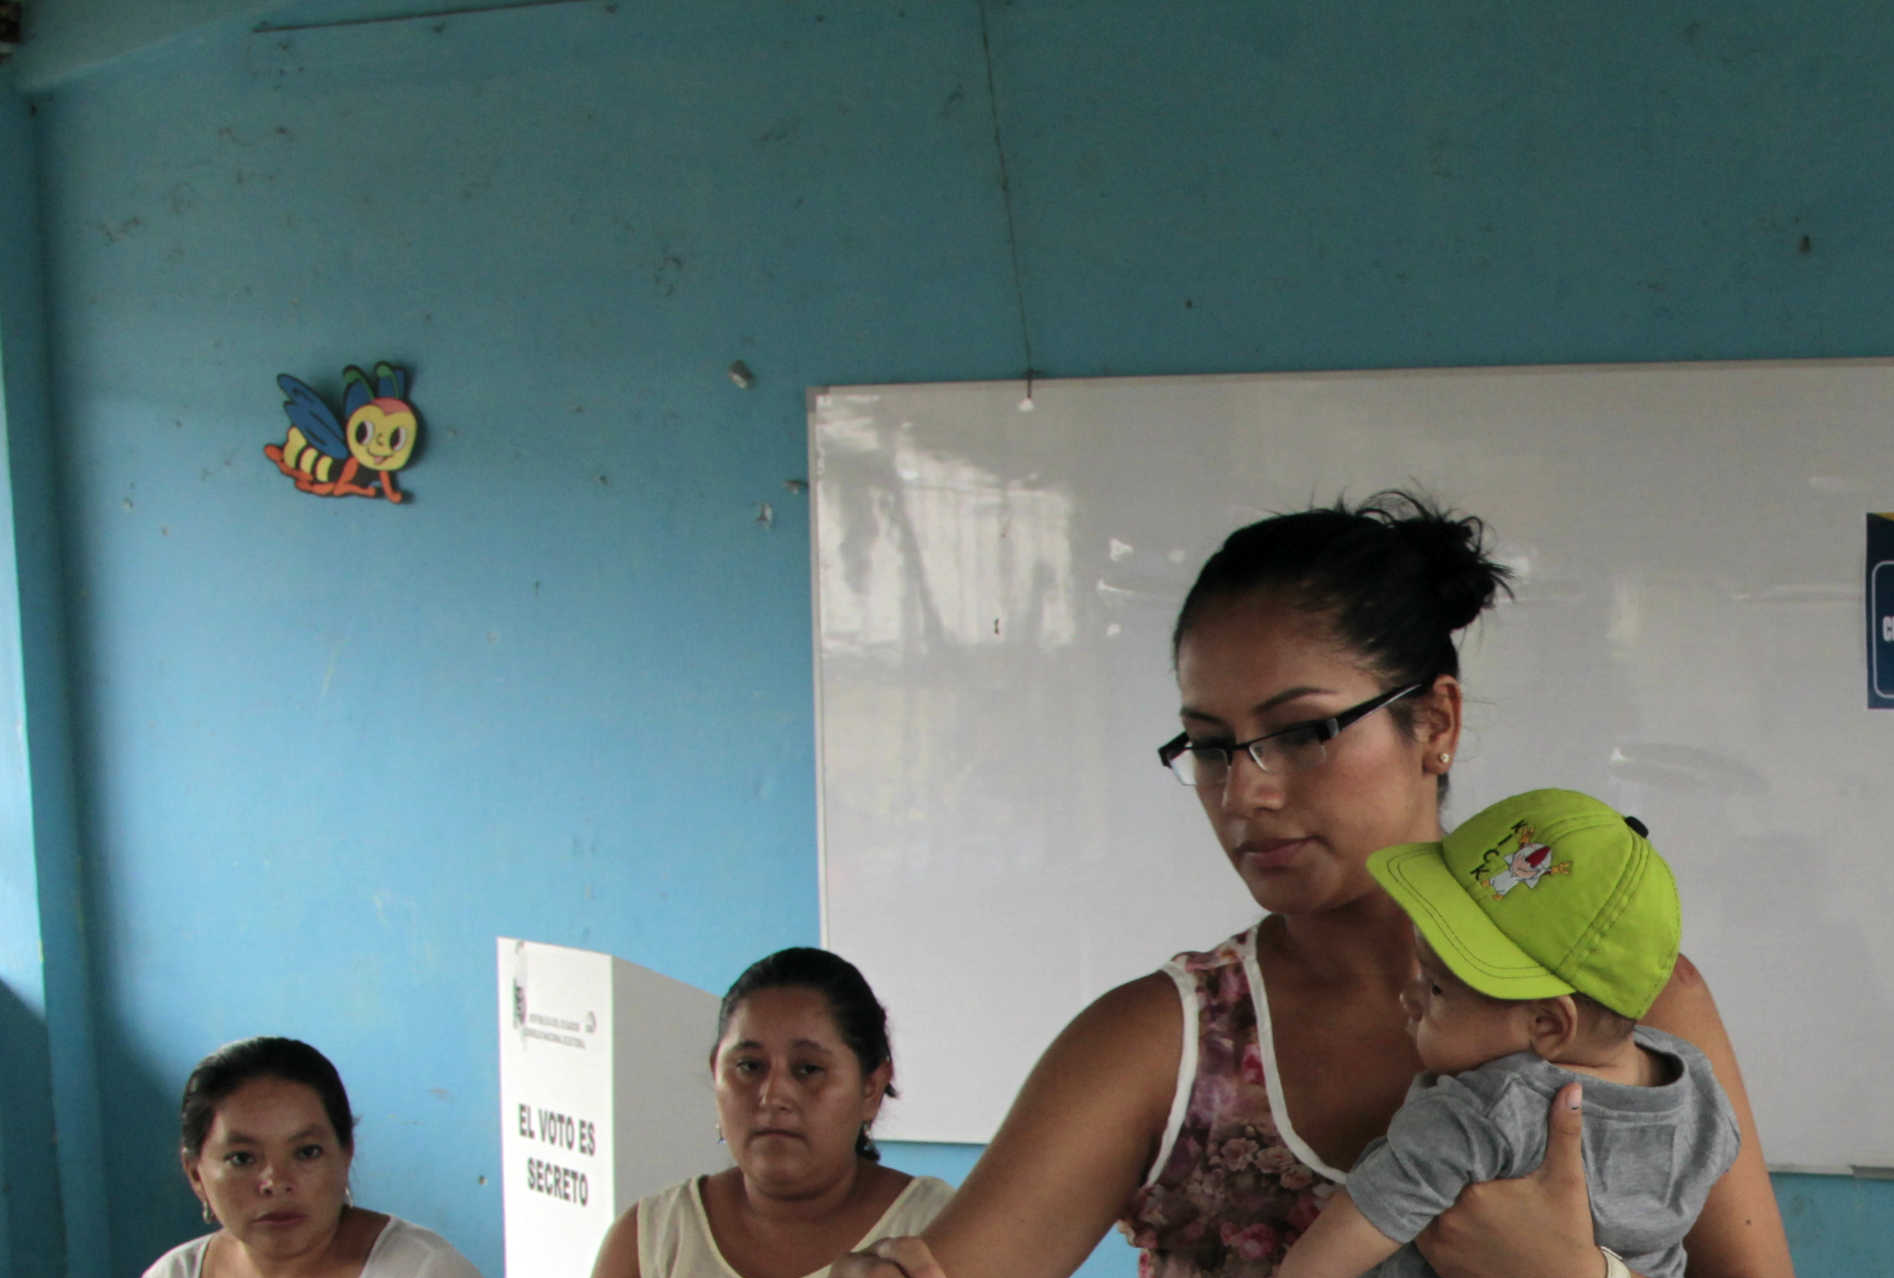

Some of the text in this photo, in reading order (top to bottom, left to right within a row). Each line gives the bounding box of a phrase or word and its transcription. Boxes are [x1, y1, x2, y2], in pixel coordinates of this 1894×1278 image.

[518, 1102, 596, 1157] EL VOTO ES
[527, 1157, 589, 1207] SECRETO
